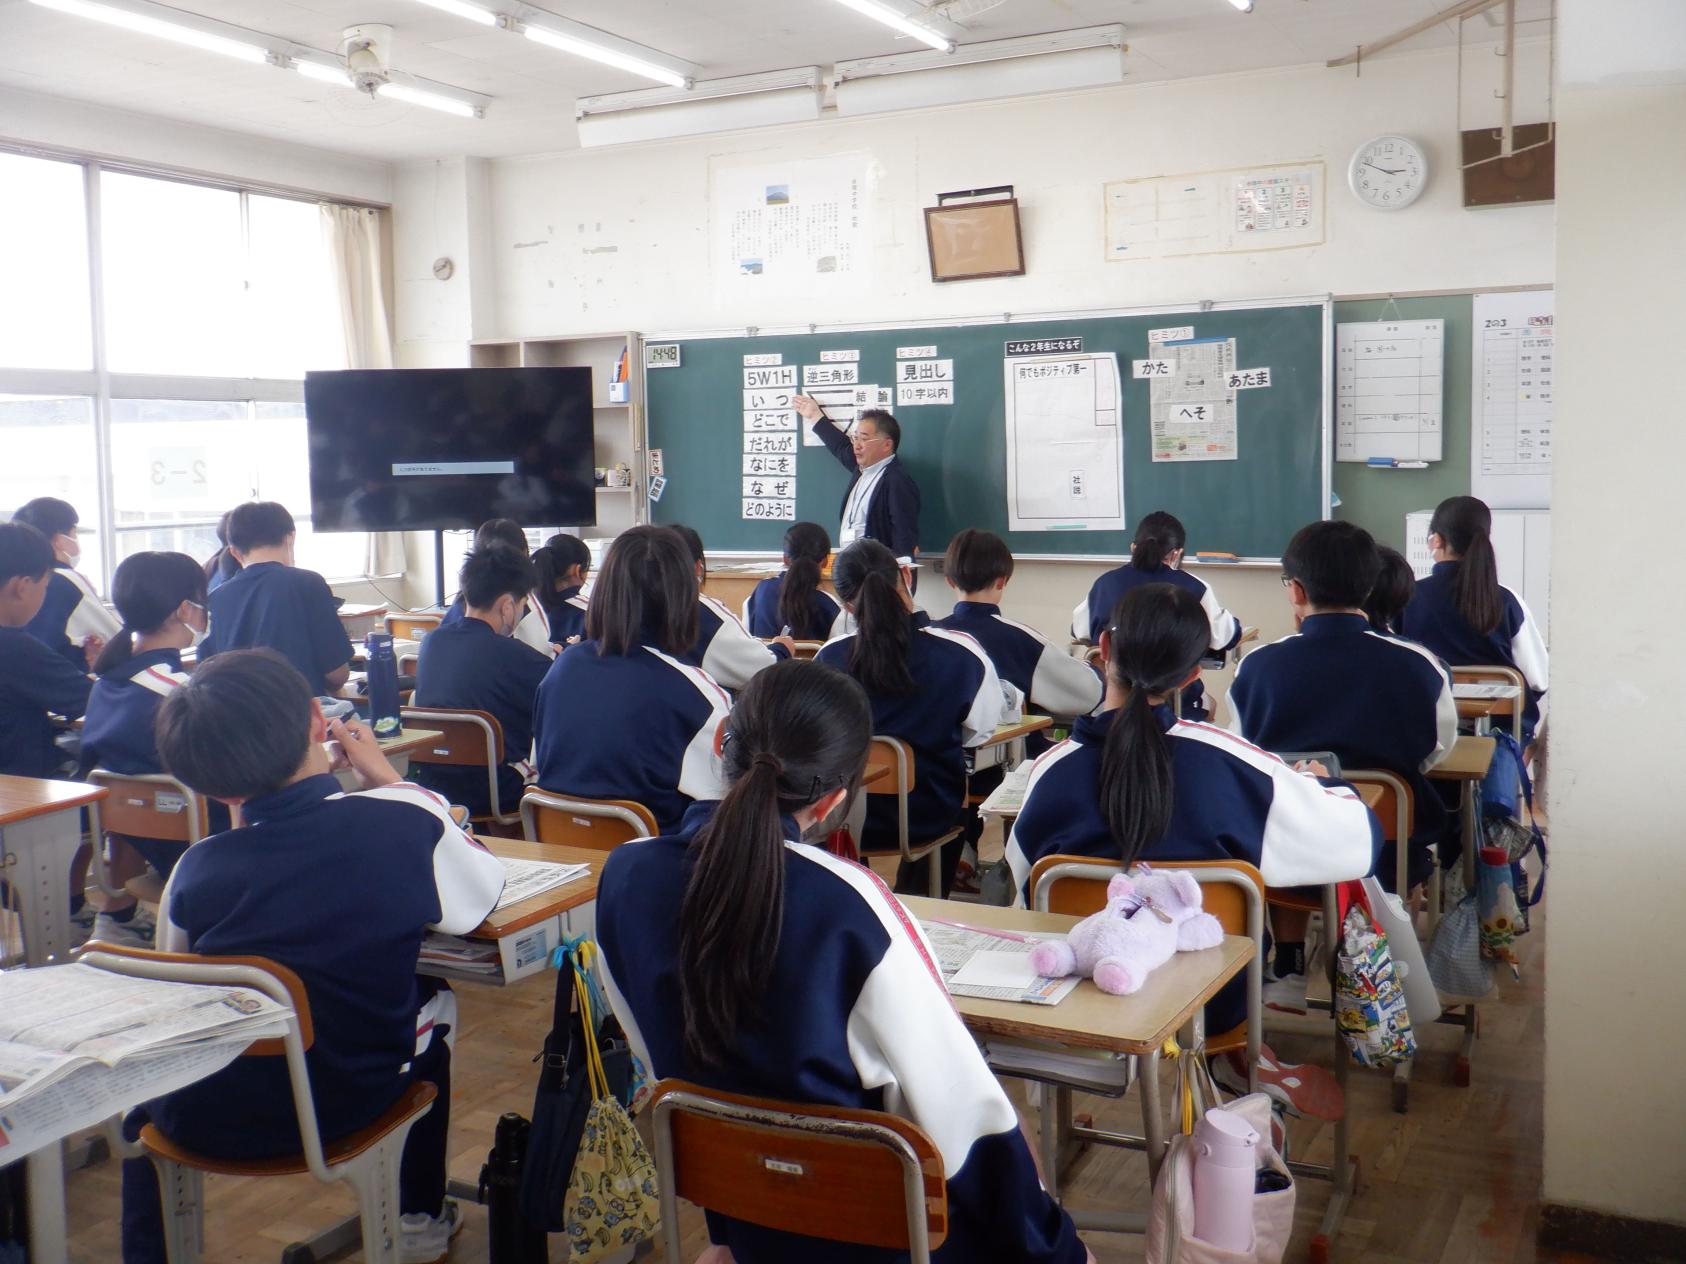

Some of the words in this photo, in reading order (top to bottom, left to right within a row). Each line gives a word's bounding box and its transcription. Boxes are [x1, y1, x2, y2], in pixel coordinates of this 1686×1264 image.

[904, 363, 946, 380] 見出し
[1142, 361, 1169, 375] かた
[747, 369, 792, 386] 5W1H
[807, 369, 855, 384] 逆三角形
[1228, 370, 1269, 388] あたま
[901, 387, 948, 400] 10字以内
[752, 413, 790, 428] どこで
[1179, 406, 1207, 420] へそ
[749, 436, 793, 452] だれが
[750, 457, 790, 472] なにを
[745, 502, 793, 517] どのように
